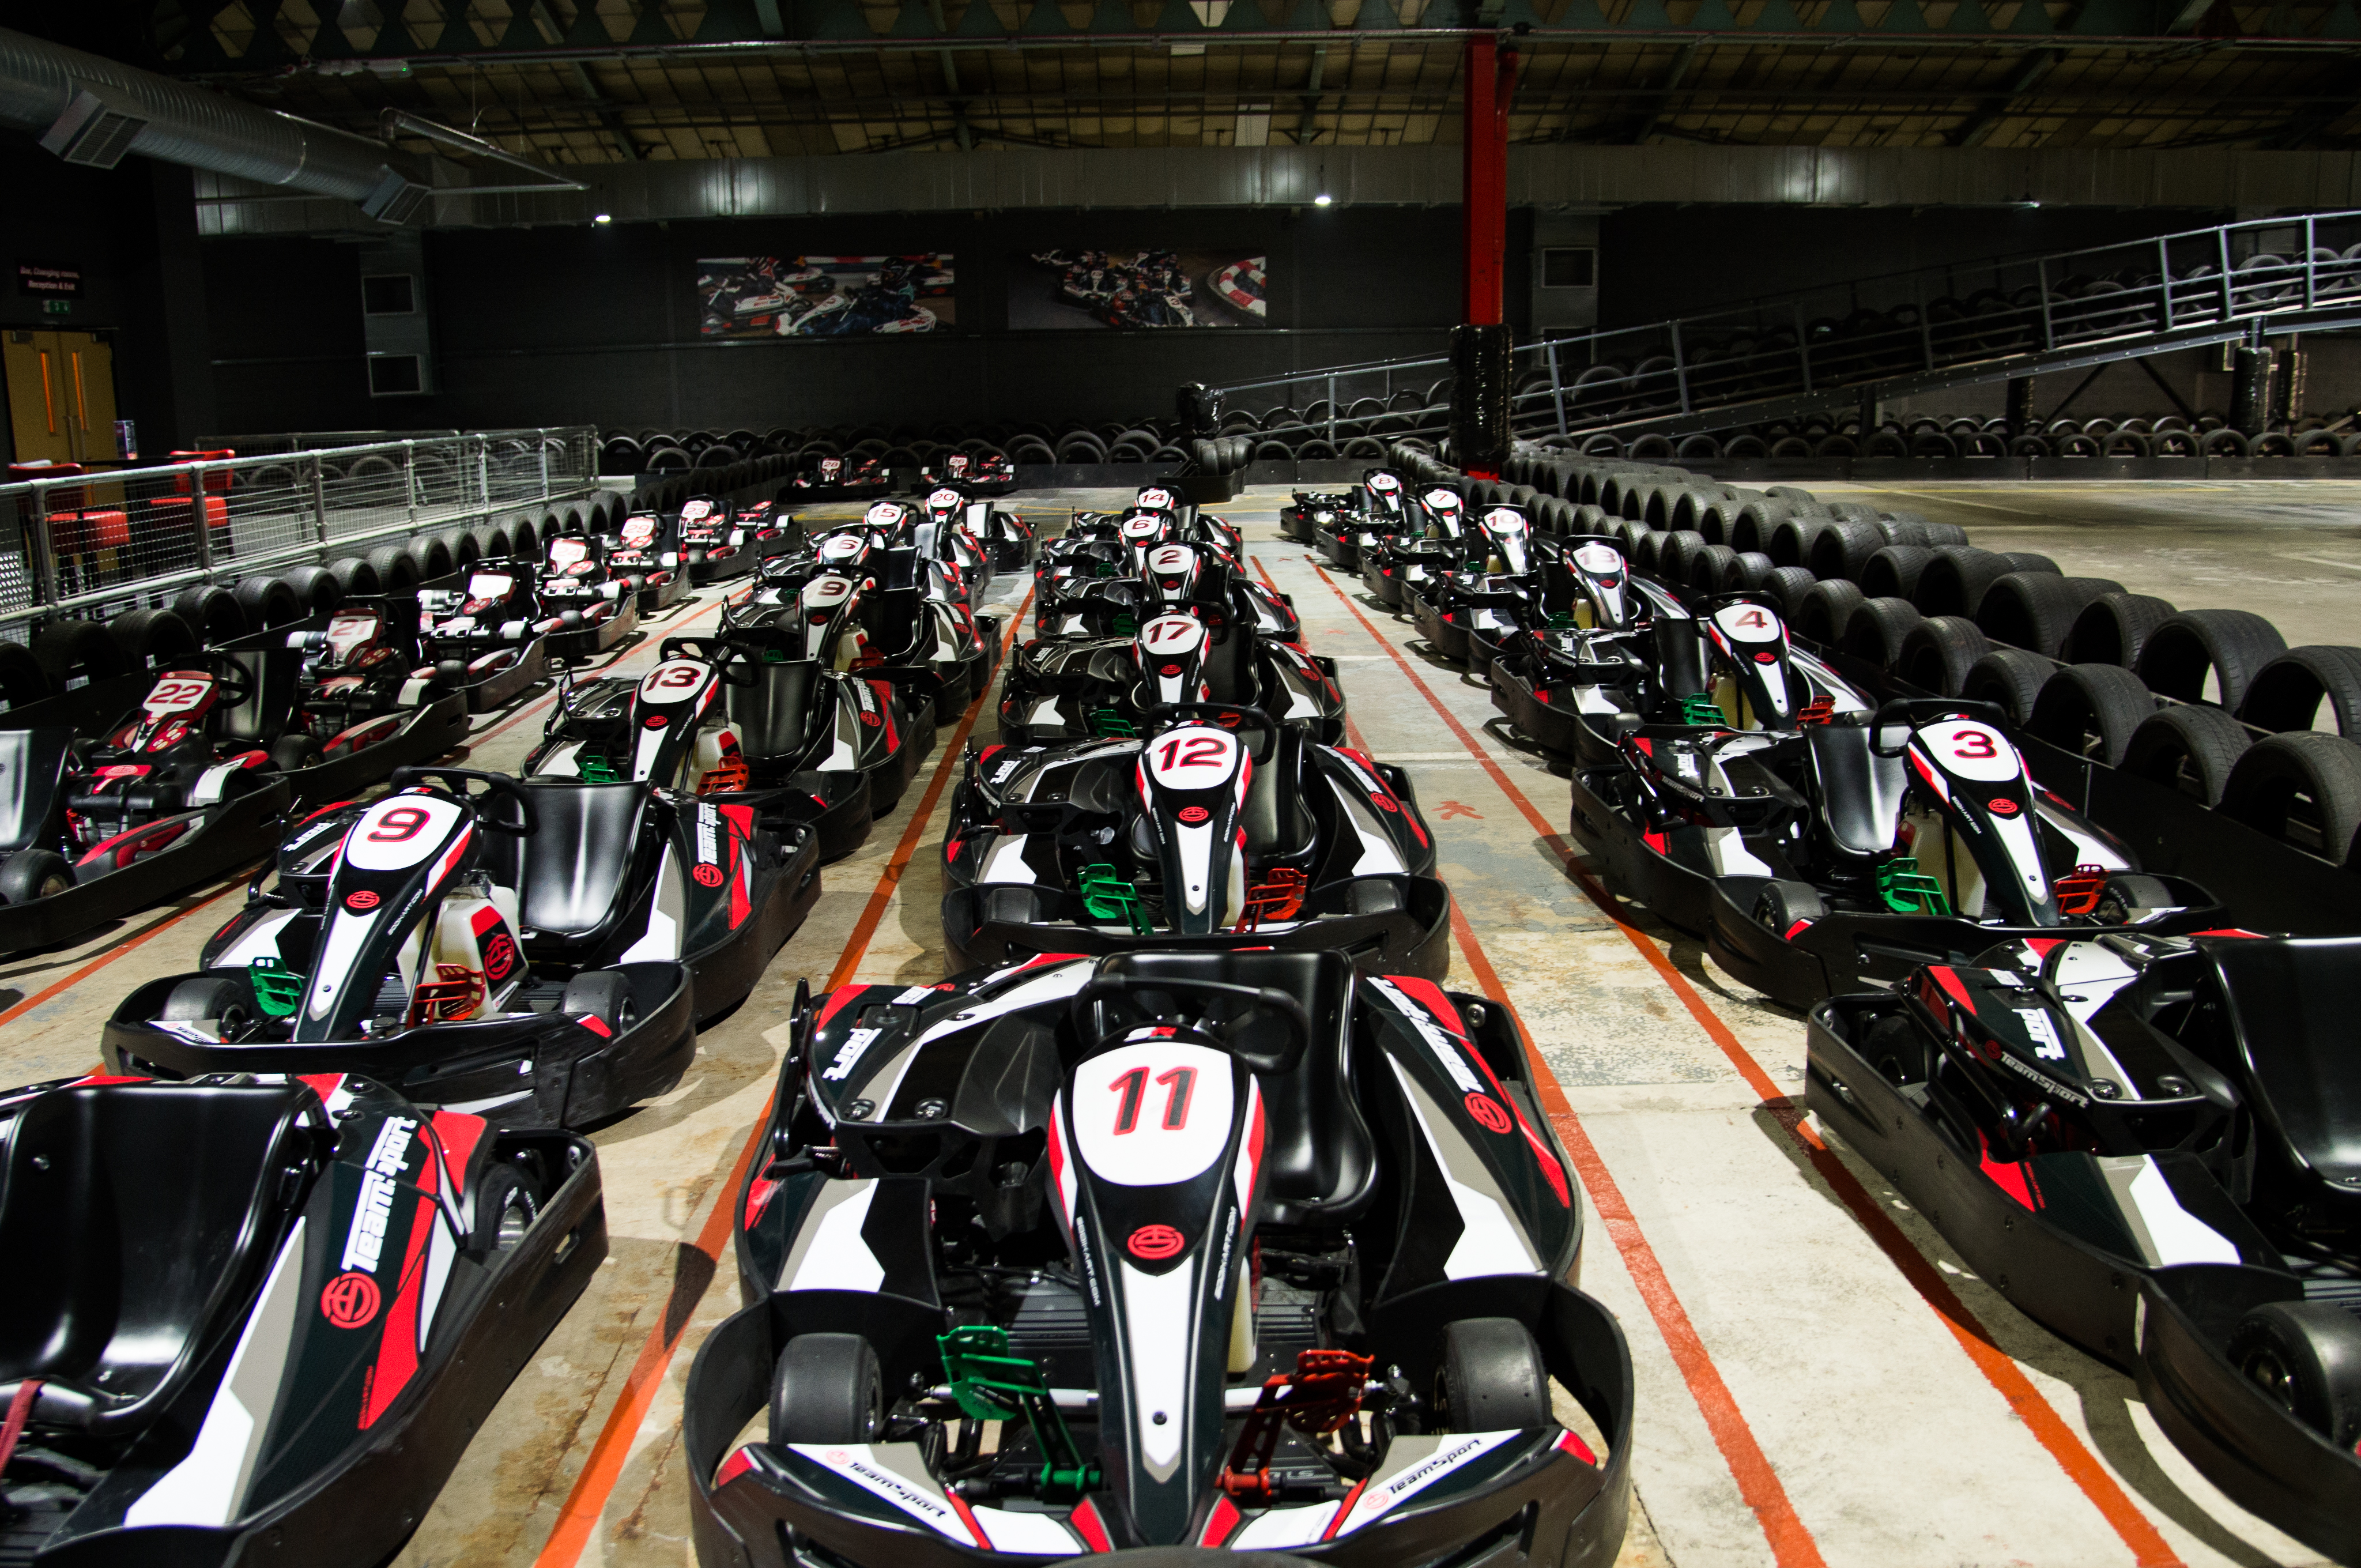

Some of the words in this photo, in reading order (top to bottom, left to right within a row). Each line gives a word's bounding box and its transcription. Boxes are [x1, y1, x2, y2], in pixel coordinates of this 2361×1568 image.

[28, 280, 58, 290] Reception
[933, 493, 955, 503] 20
[1142, 493, 1165, 503] 14
[1435, 493, 1448, 502] 7
[684, 507, 706, 515] 23
[872, 508, 897, 519] 15
[625, 524, 649, 534] 29
[1132, 520, 1150, 530] 6
[1489, 514, 1519, 527] 10
[1158, 549, 1182, 565] 2
[807, 581, 846, 599] 19
[332, 619, 372, 636] 21
[1735, 610, 1767, 628] 4
[1148, 621, 1195, 644] 17
[645, 666, 700, 692] 13
[147, 684, 204, 704] 22
[1952, 730, 1997, 759] 3
[1159, 737, 1227, 771] 12
[367, 807, 431, 842] 9
[2001, 1051, 2089, 1108] TeamSport
[1108, 1066, 1198, 1136] 11
[340, 1116, 417, 1273] TeamSport
[1386, 1438, 1483, 1494] TeamSport
[849, 1463, 946, 1518] TeamSport
